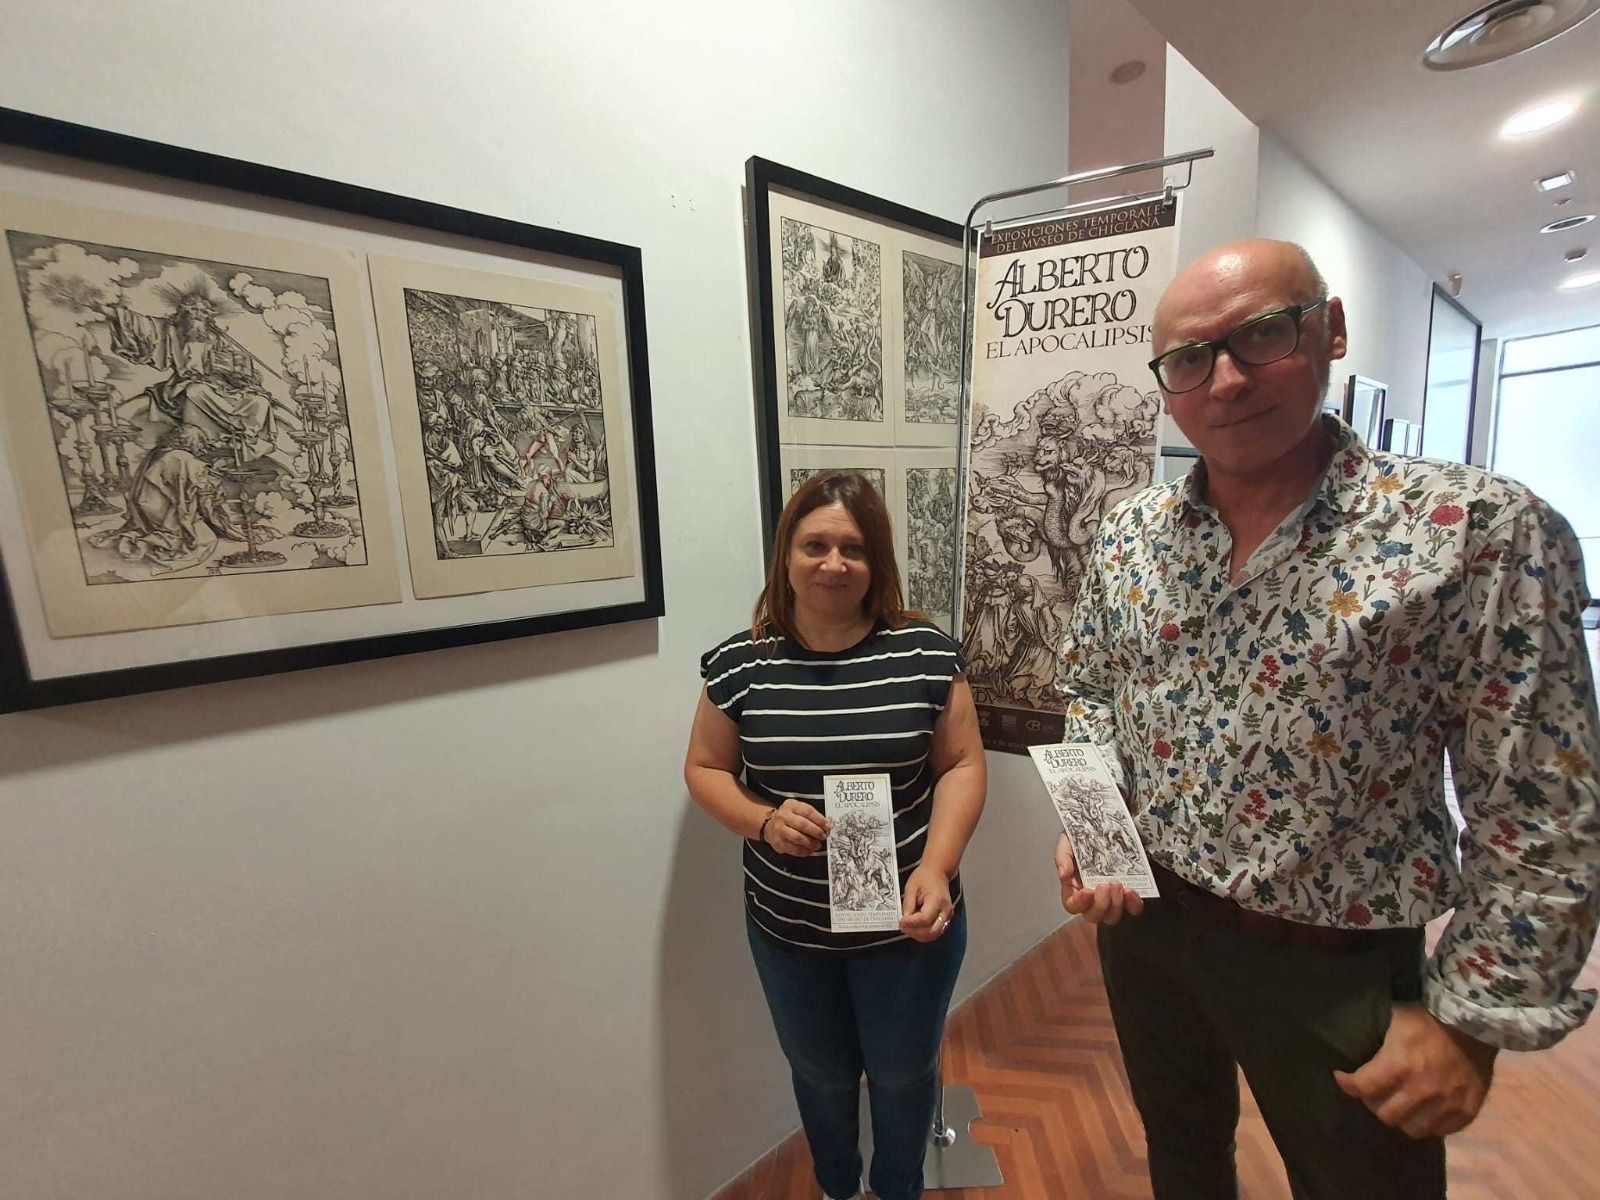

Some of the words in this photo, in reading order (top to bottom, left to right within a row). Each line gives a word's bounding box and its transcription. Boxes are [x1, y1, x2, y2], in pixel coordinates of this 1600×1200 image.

[991, 220, 1079, 244] EXPOSICIONES
[1083, 203, 1167, 228] TEMPORALES
[996, 242, 1017, 254] DEL
[1068, 231, 1085, 241] DE
[1088, 216, 1160, 238] CHICLANA
[986, 245, 1149, 310] ALBERTO
[994, 288, 1137, 338] DURERO
[986, 341, 1010, 359] EL
[1044, 748, 1085, 762] ALBERTO
[834, 780, 875, 793] ALBERTO
[835, 791, 874, 803] DURERO
